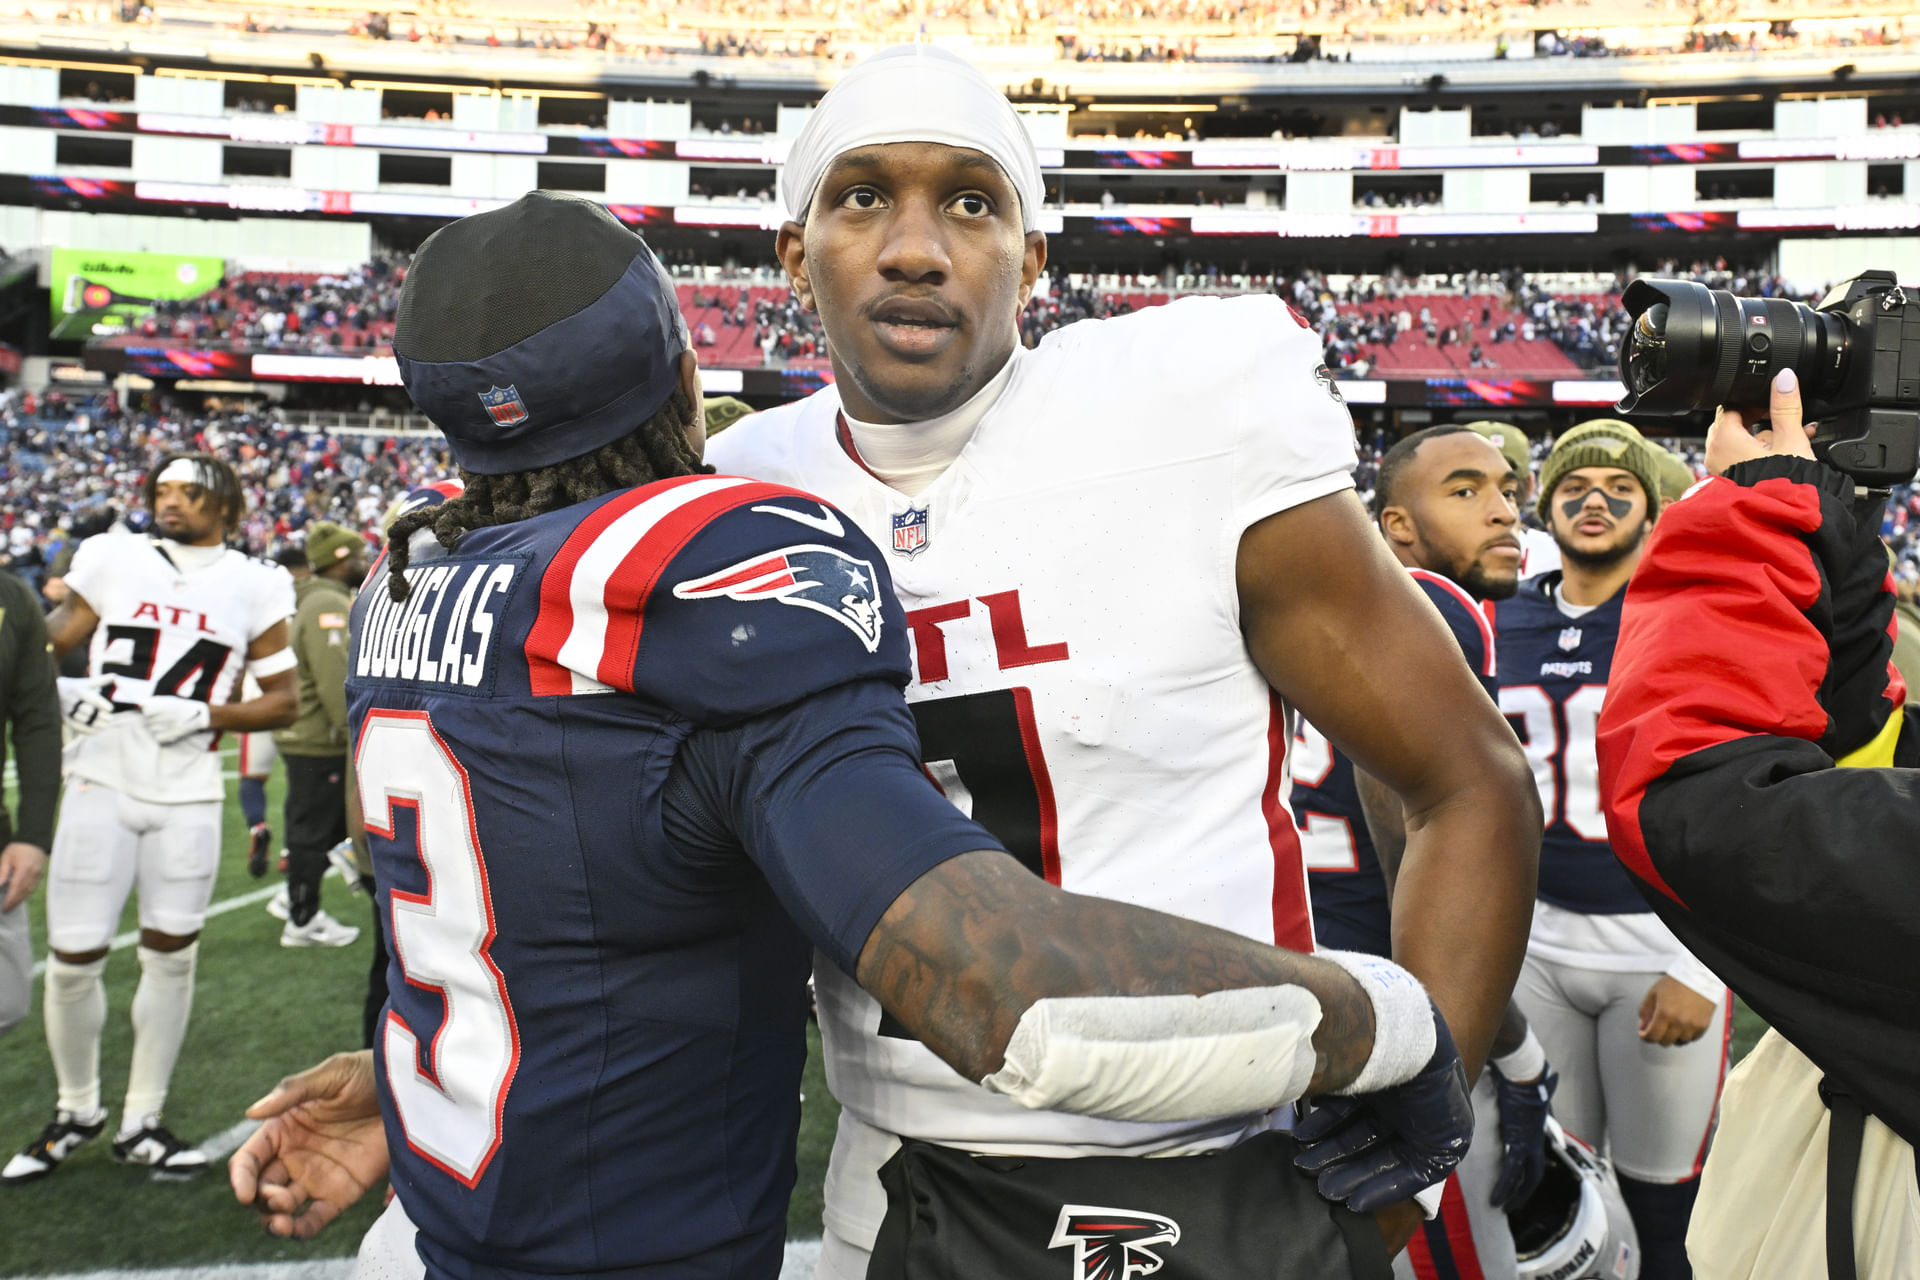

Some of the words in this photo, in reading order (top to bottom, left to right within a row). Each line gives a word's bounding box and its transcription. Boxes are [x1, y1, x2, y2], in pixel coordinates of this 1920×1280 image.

[490, 403, 525, 423] NFL
[895, 525, 924, 549] NFL
[132, 601, 217, 635] ATL
[356, 563, 515, 688] DOUGLAS
[905, 589, 1070, 684] TL
[355, 707, 521, 1190] 3
